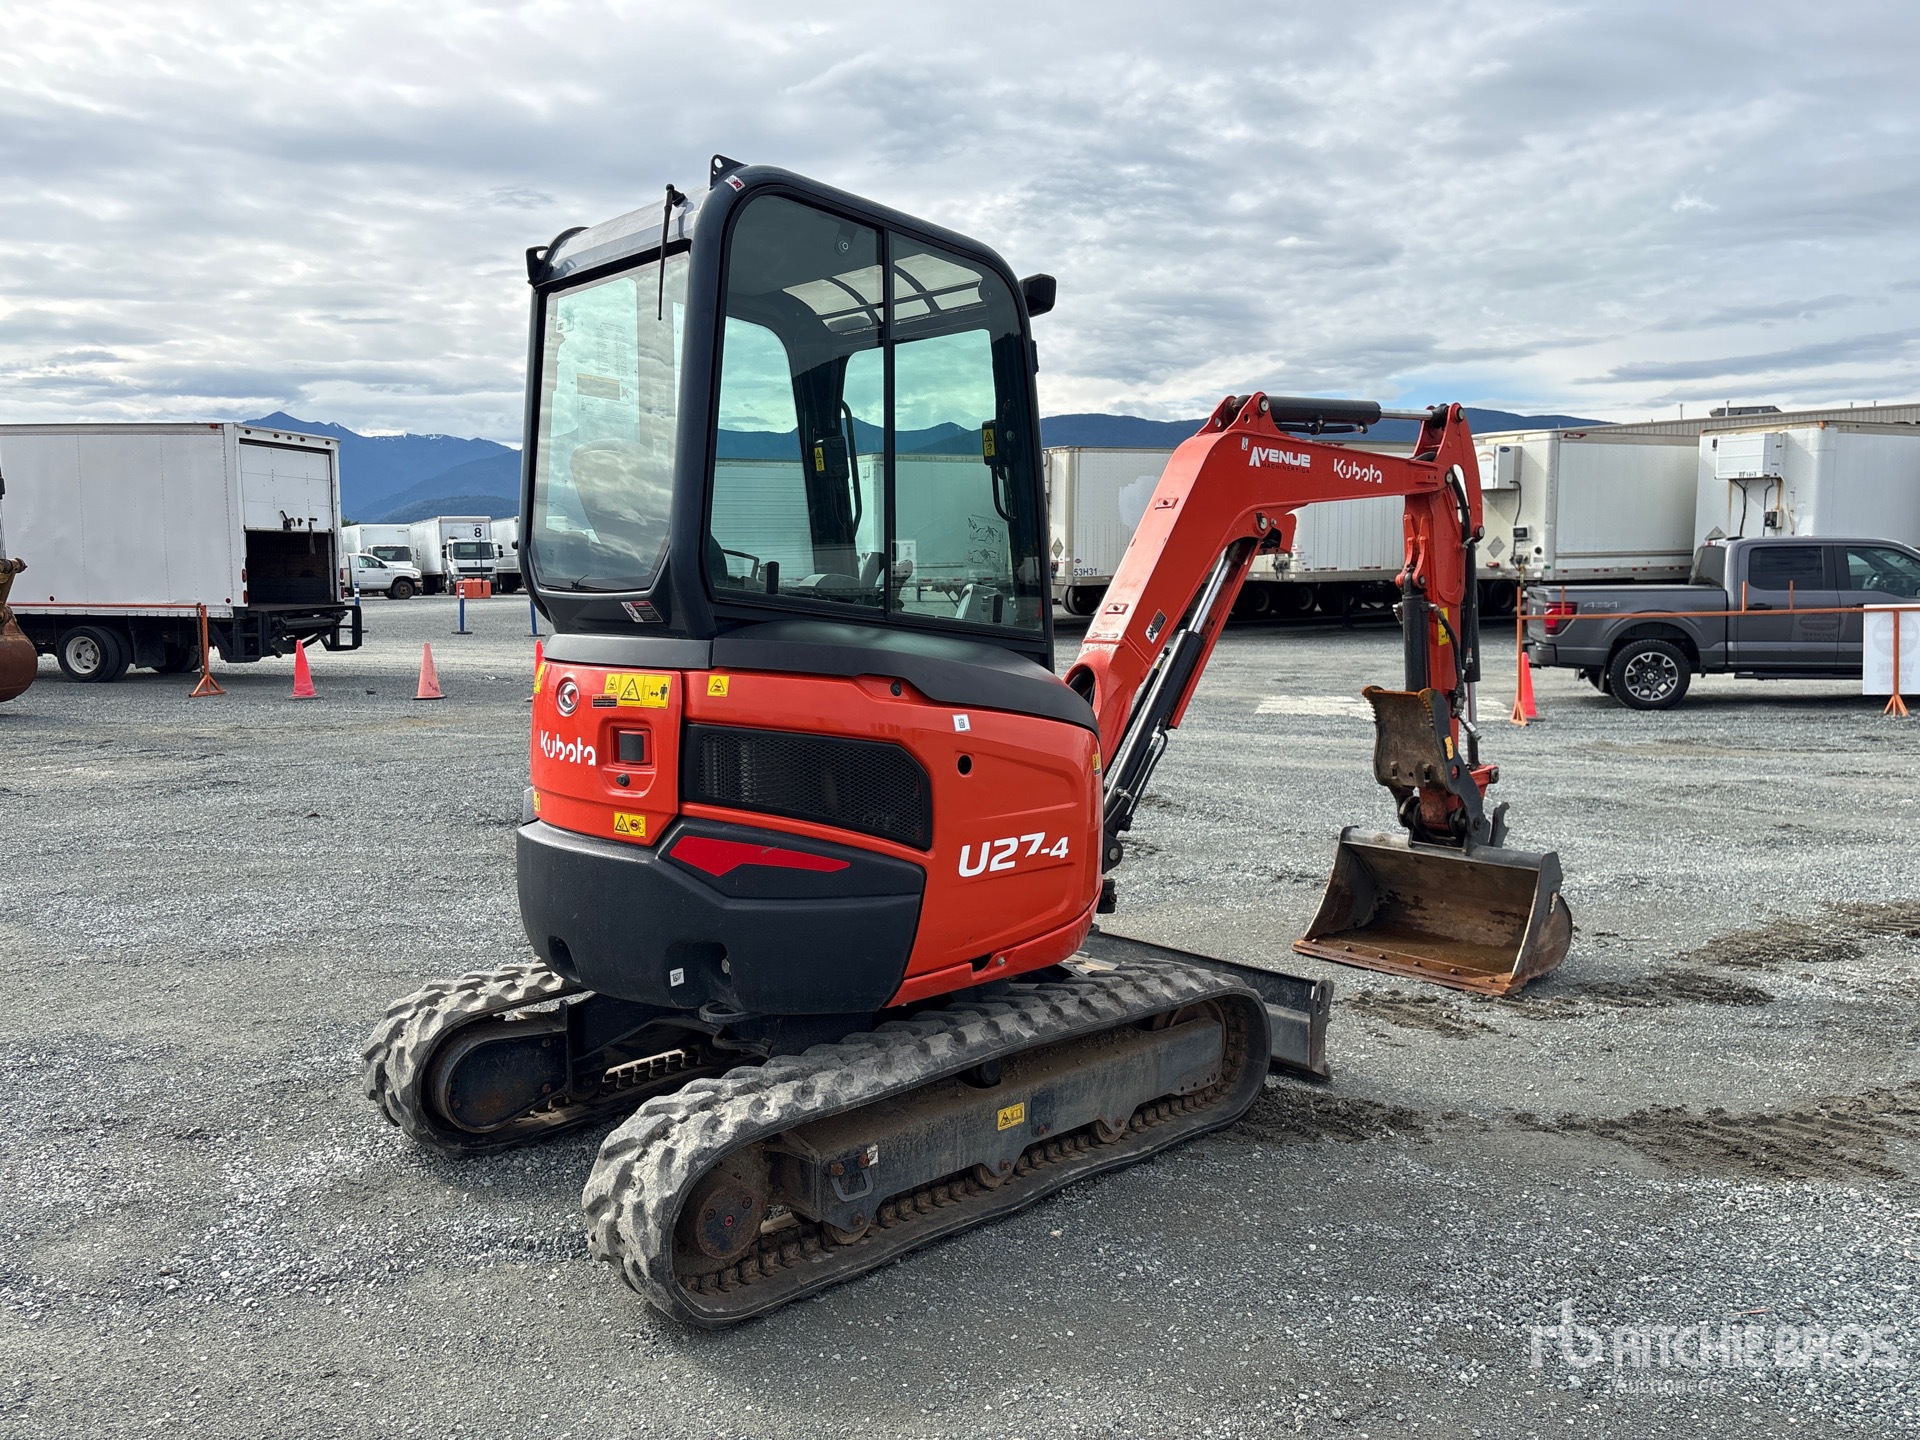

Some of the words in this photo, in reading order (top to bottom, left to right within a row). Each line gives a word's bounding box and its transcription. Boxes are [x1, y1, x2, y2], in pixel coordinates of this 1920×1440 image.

[1249, 446, 1311, 468] AVENUE
[1333, 458, 1382, 484] Kubota
[474, 527, 482, 538] 8
[1073, 567, 1098, 577] 53H31
[540, 729, 597, 767] Kubota
[958, 831, 1069, 878] U27-4
